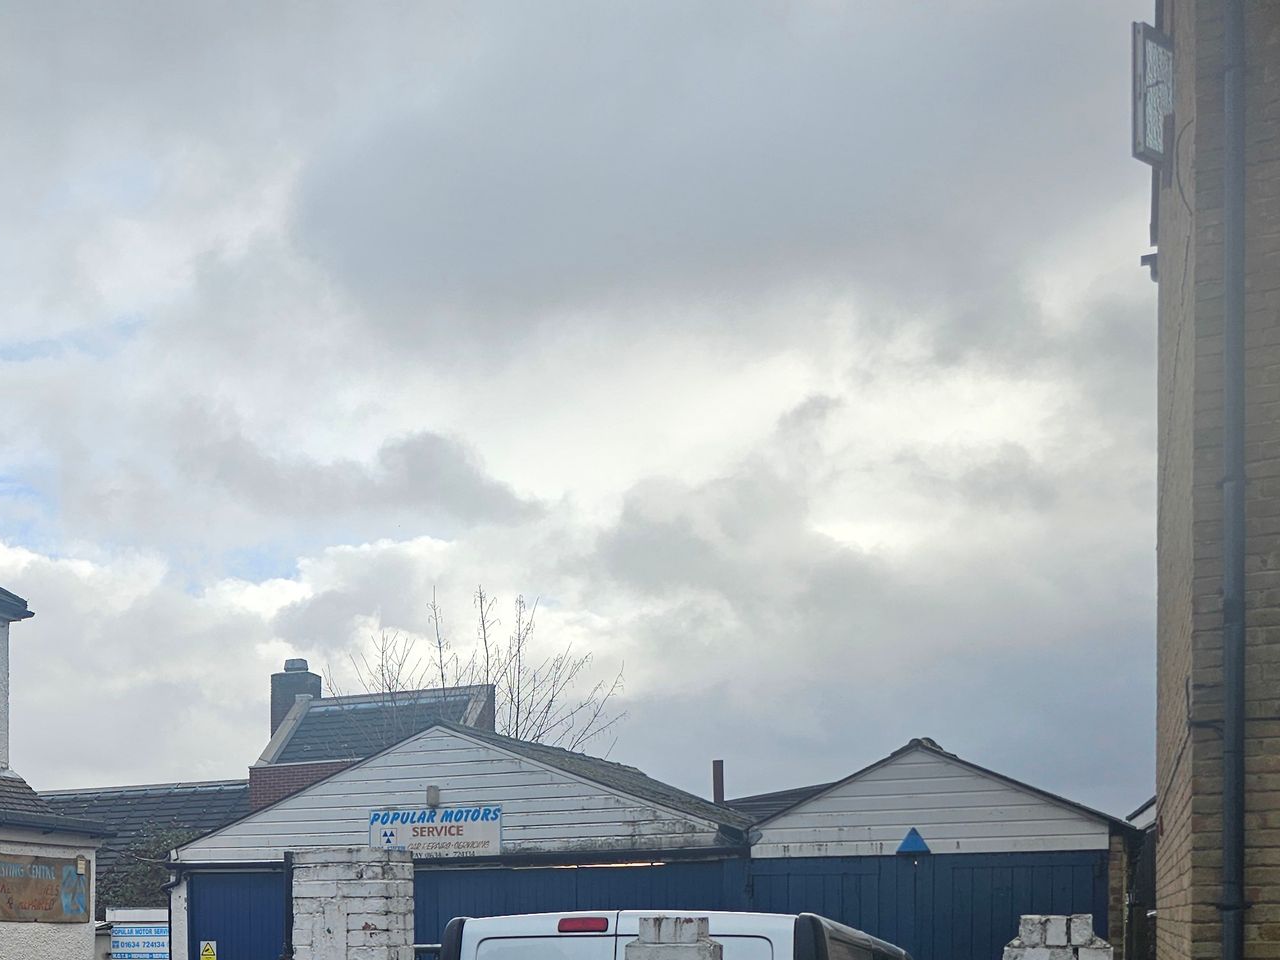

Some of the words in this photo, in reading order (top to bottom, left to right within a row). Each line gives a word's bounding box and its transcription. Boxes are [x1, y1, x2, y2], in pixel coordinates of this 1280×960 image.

[370, 808, 436, 826] POPULAR
[440, 807, 502, 824] MOTORS
[411, 825, 464, 837] SERVICE
